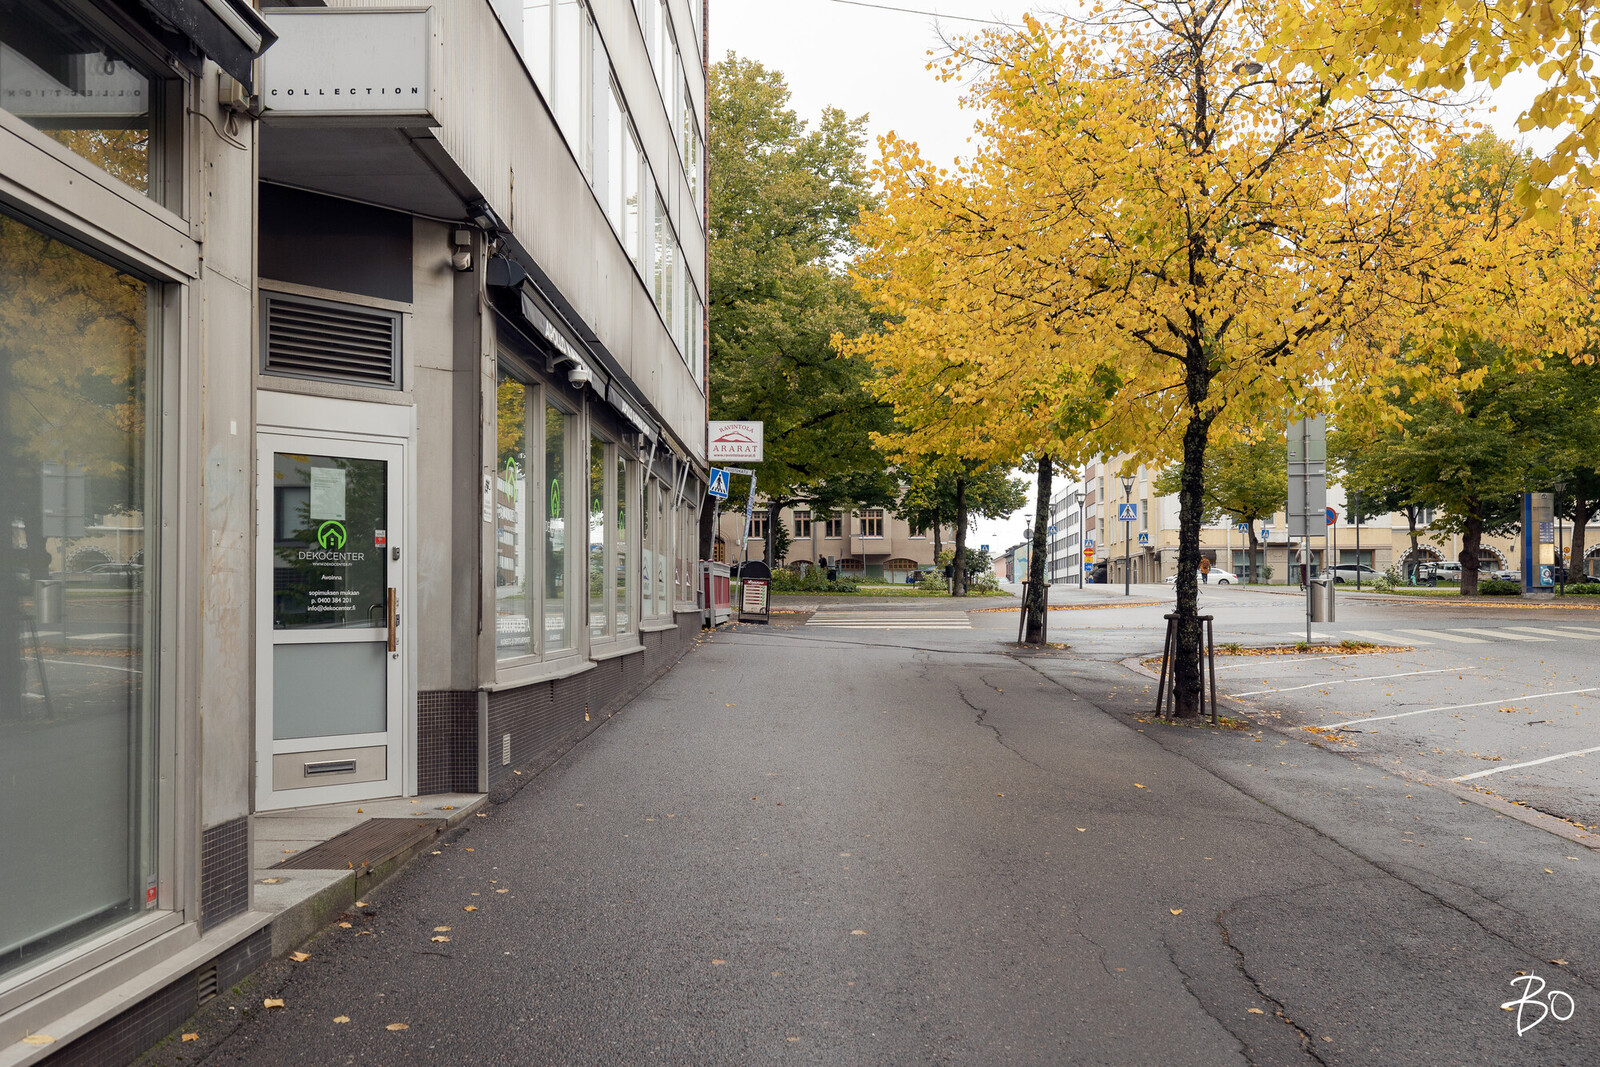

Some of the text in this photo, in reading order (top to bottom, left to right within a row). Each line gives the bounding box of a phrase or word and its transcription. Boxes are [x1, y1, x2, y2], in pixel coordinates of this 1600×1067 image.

[271, 87, 418, 96] COLLECTION
[719, 424, 754, 433] RAVINTOLA
[713, 445, 758, 453] ARARAT
[298, 551, 365, 561] DEKOCENTER
